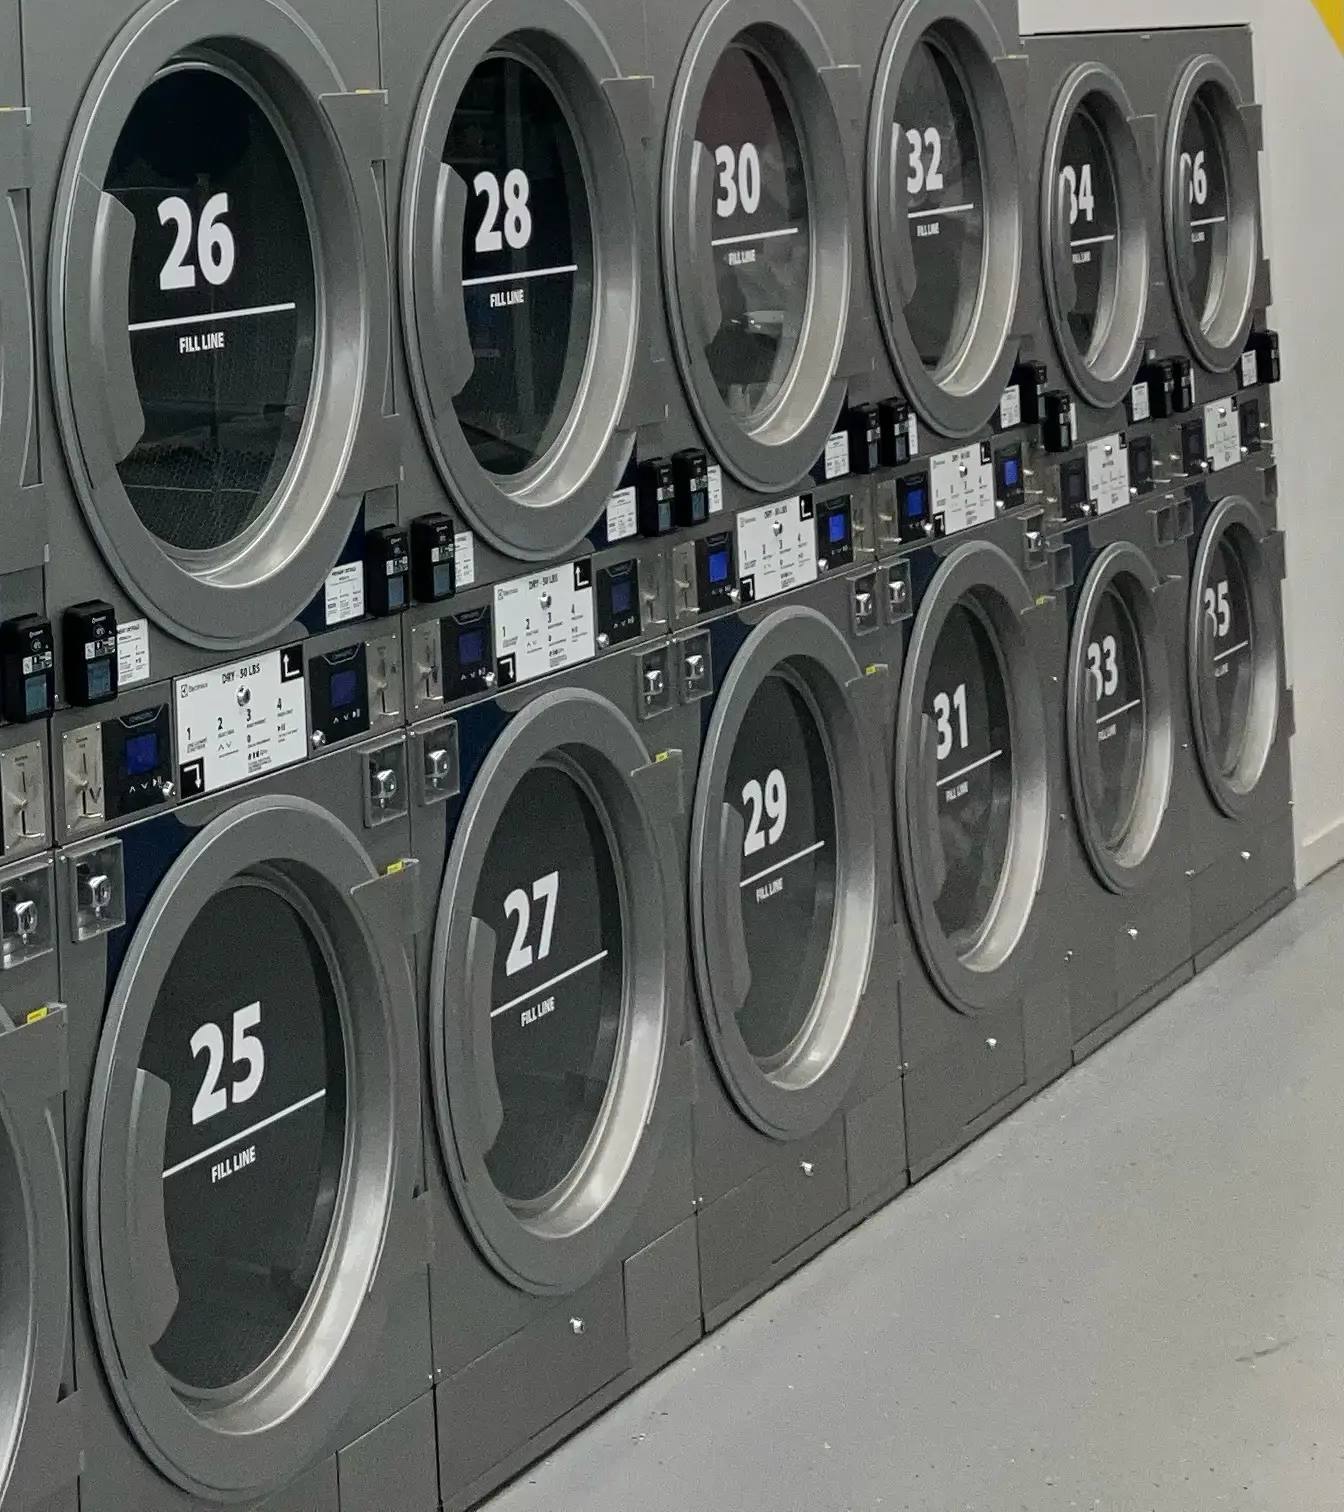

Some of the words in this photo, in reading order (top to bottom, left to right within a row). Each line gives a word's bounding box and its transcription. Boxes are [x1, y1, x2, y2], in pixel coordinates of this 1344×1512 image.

[715, 142, 761, 218] 30
[906, 127, 943, 193] 32
[157, 192, 235, 290] 26
[474, 168, 531, 253] 28
[490, 292, 506, 308] FILL
[507, 289, 524, 305] LINE
[179, 336, 200, 354] FILL
[202, 332, 225, 350] LINE
[933, 683, 968, 760] 31
[742, 769, 787, 856] 29
[503, 870, 559, 977] 27
[521, 1007, 537, 1027] FILL
[537, 996, 555, 1017] LINE
[190, 1001, 265, 1125] 25
[211, 1159, 232, 1183] FILL
[233, 1145, 256, 1172] LINE
